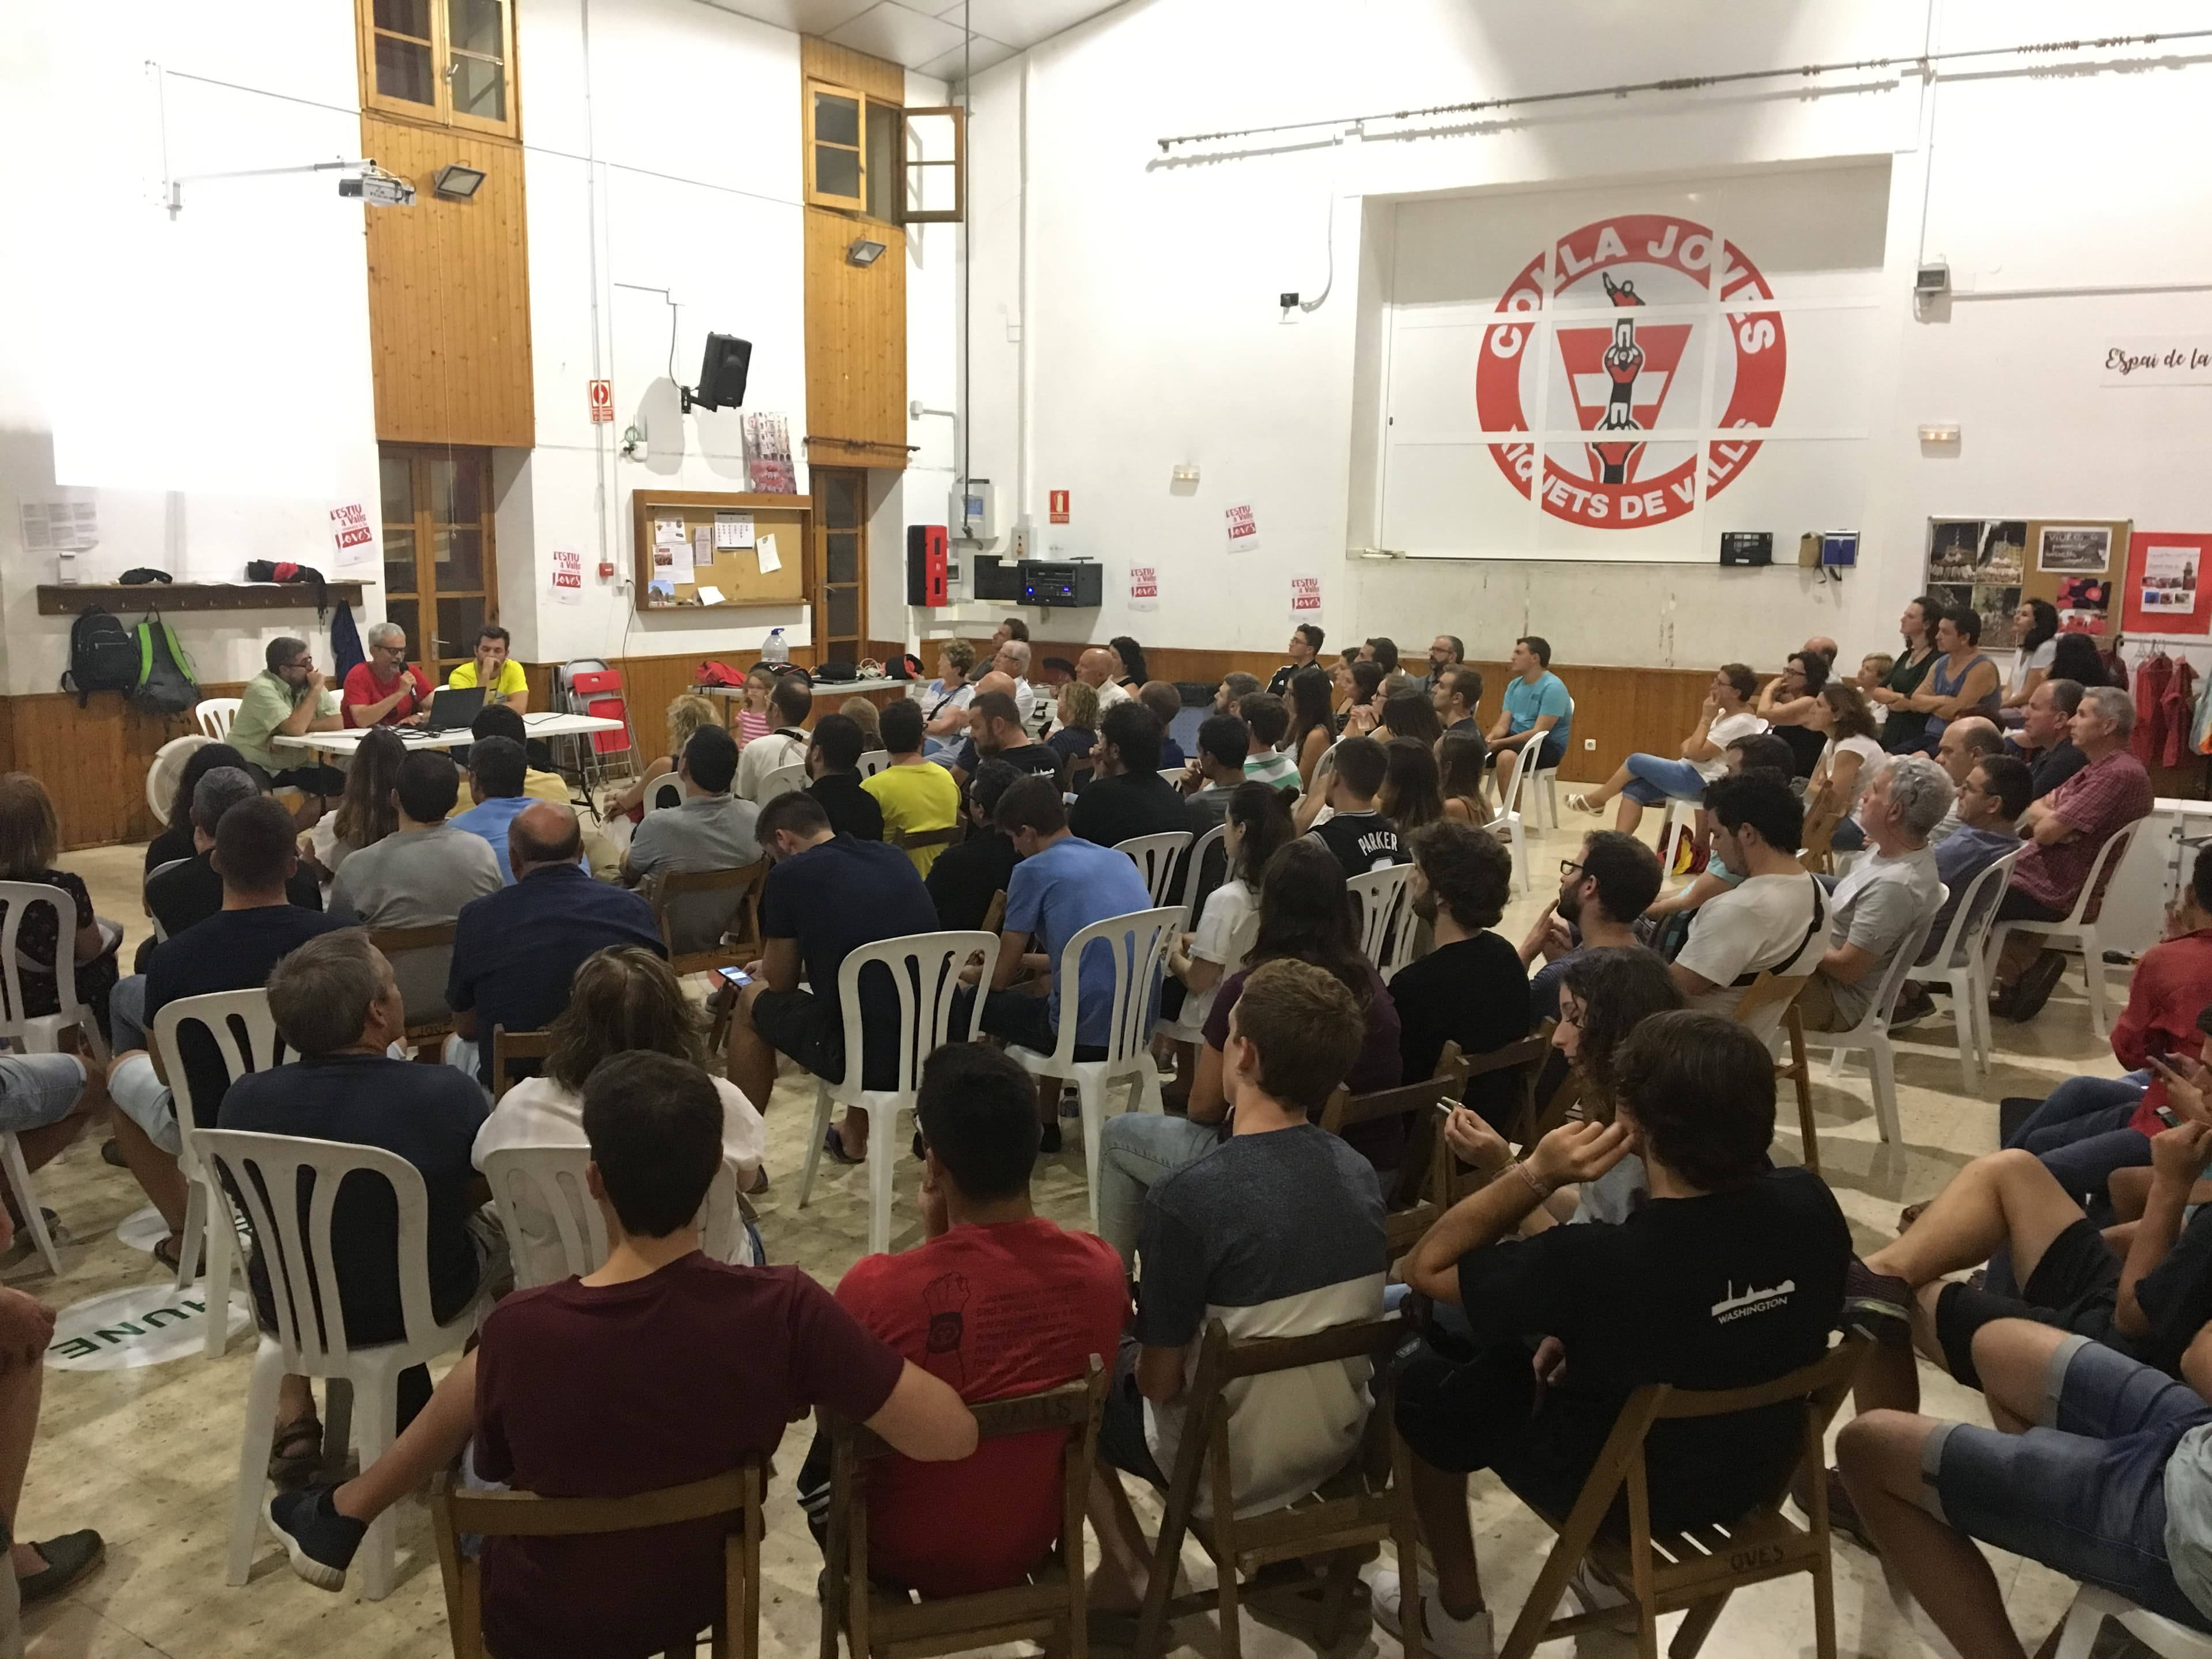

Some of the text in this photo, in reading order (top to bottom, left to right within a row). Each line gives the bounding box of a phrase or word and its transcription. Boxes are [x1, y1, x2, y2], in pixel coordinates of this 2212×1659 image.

[1491, 225, 1775, 358] COLLA JOVES
[2105, 347, 2212, 375] Espai de la
[330, 503, 362, 521] L'ESTIU
[1620, 490, 1667, 520] DE
[554, 551, 579, 562] L'ESTIU
[1292, 578, 1317, 588] L'ESTIU
[1358, 831, 1398, 857] PARKER
[1718, 1296, 1787, 1324] WASHINGTON
